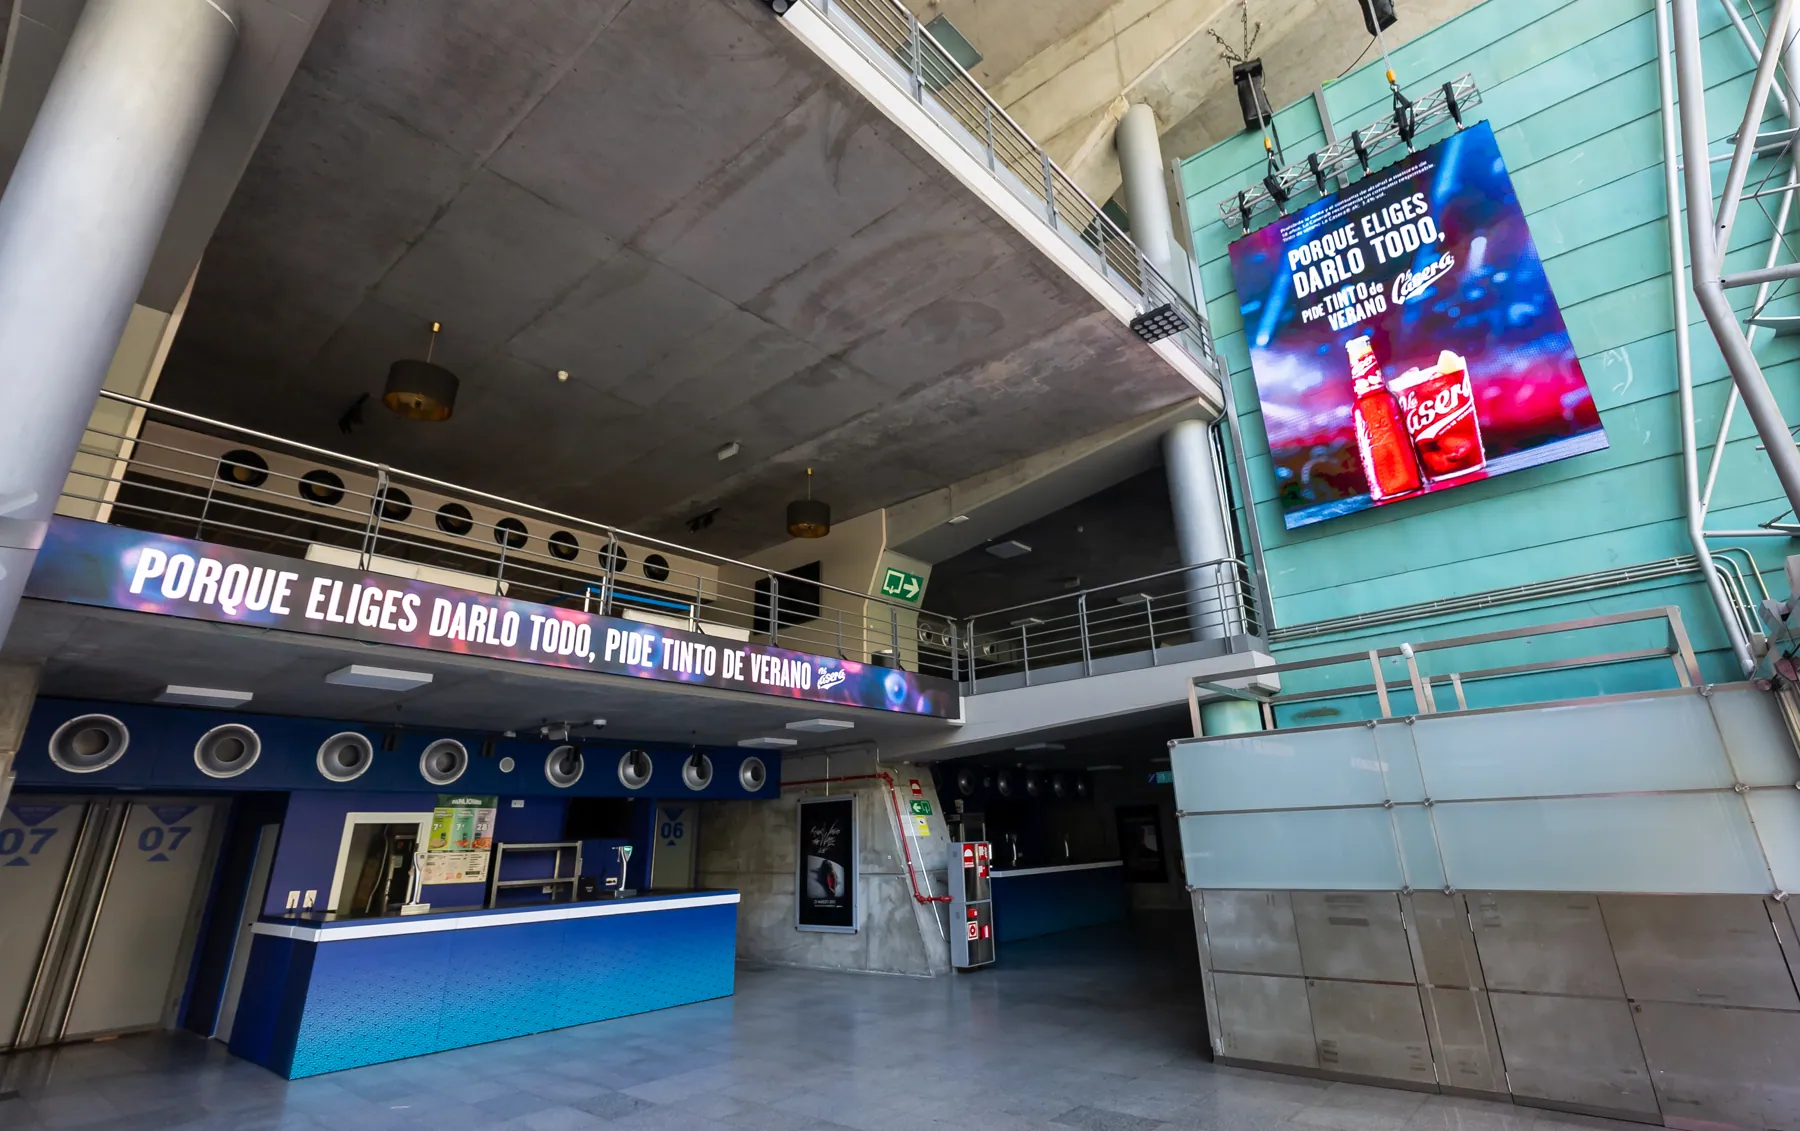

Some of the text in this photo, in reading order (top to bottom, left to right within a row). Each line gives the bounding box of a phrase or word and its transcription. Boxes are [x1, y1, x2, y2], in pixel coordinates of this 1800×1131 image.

[1288, 192, 1428, 271] PORQUE ELIGES
[1293, 216, 1446, 299] DARLO TODO,
[1301, 281, 1385, 324] PIDE TINTO de
[1327, 294, 1388, 332] VERANO
[129, 547, 299, 616] PORQUE
[304, 576, 421, 633] ELIGES
[428, 597, 519, 648] DARLO
[529, 614, 596, 664] TODO,
[605, 632, 653, 669] PIDE
[661, 636, 717, 678] TINTO
[722, 648, 745, 682] DE
[750, 652, 812, 691] VERANO
[0, 827, 58, 855] 07
[138, 826, 192, 851] 07
[660, 822, 685, 839] 06
